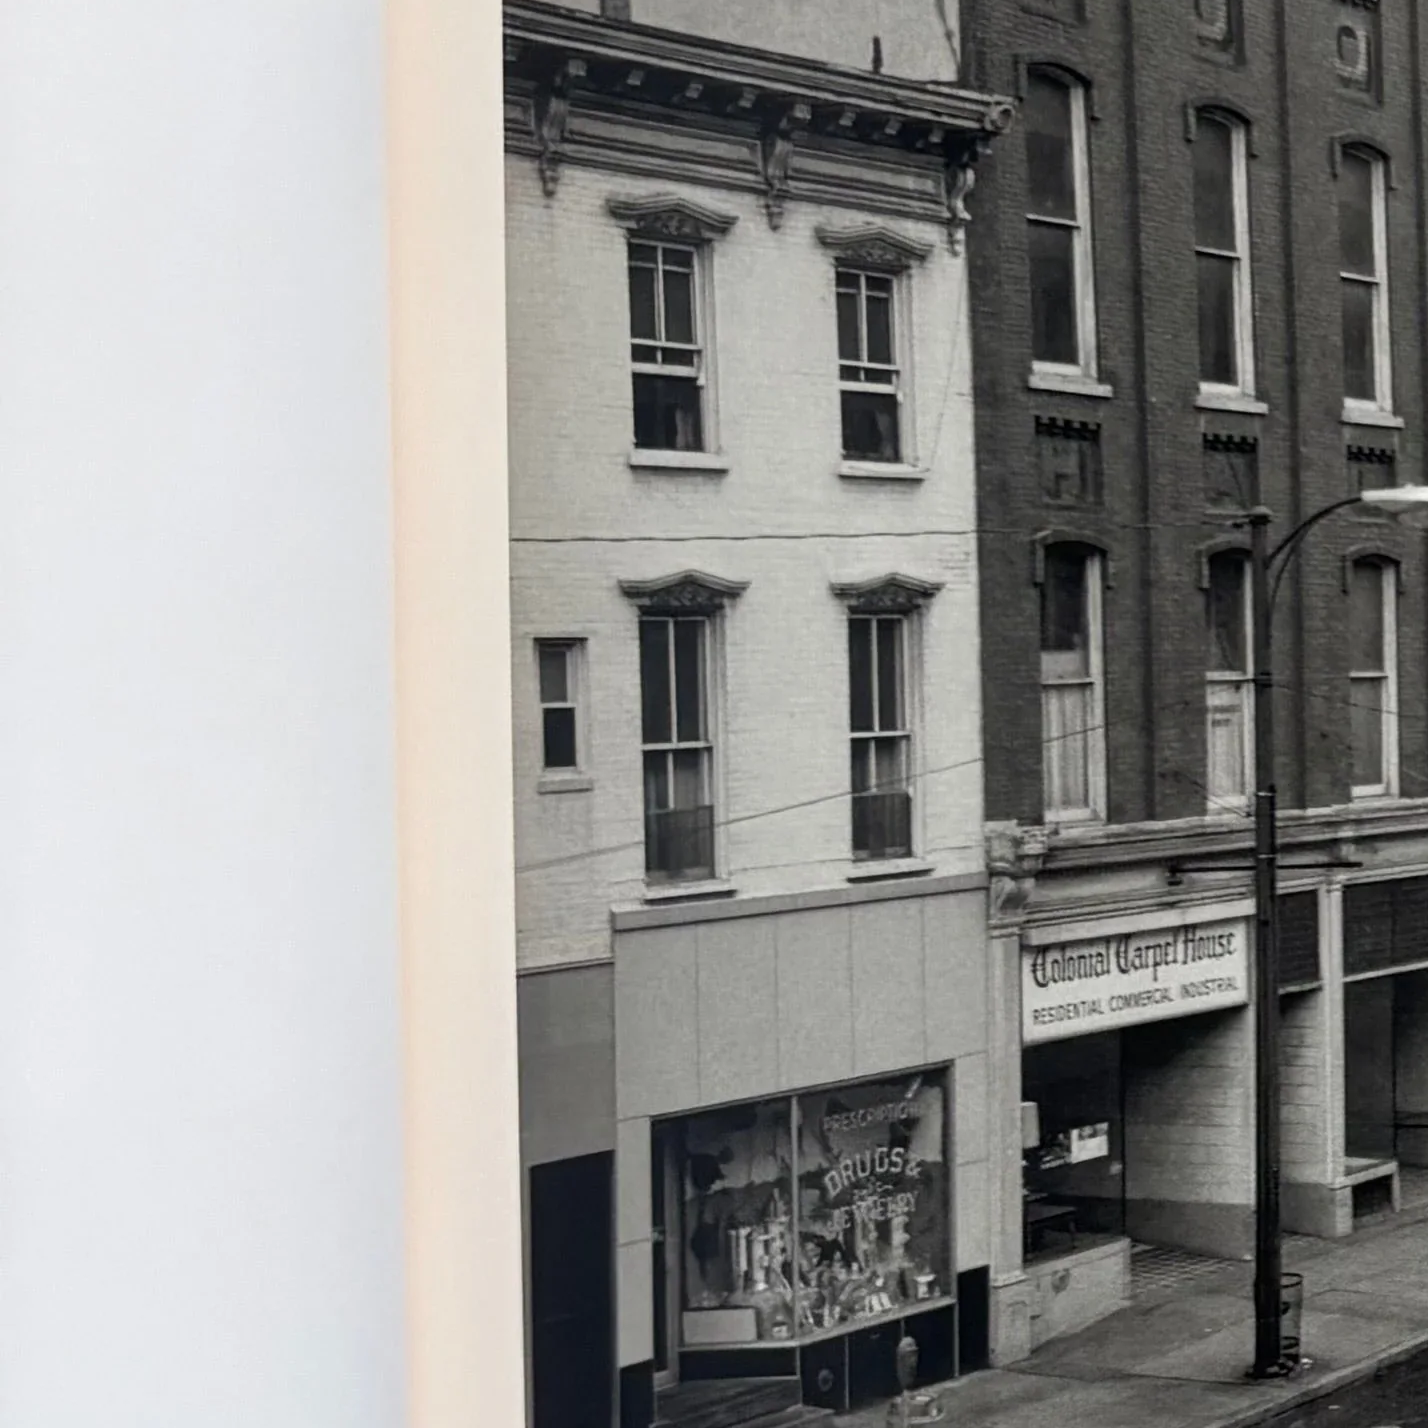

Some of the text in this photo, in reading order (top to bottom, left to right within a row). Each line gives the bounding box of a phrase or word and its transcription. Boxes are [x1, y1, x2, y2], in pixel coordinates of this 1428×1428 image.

[1031, 939, 1110, 988] Colonial
[1182, 924, 1237, 964] House
[1033, 976, 1239, 1025] RESIDENTIAL COMMERCIAL INDUSTRIAL
[824, 1147, 905, 1199] DRUGS
